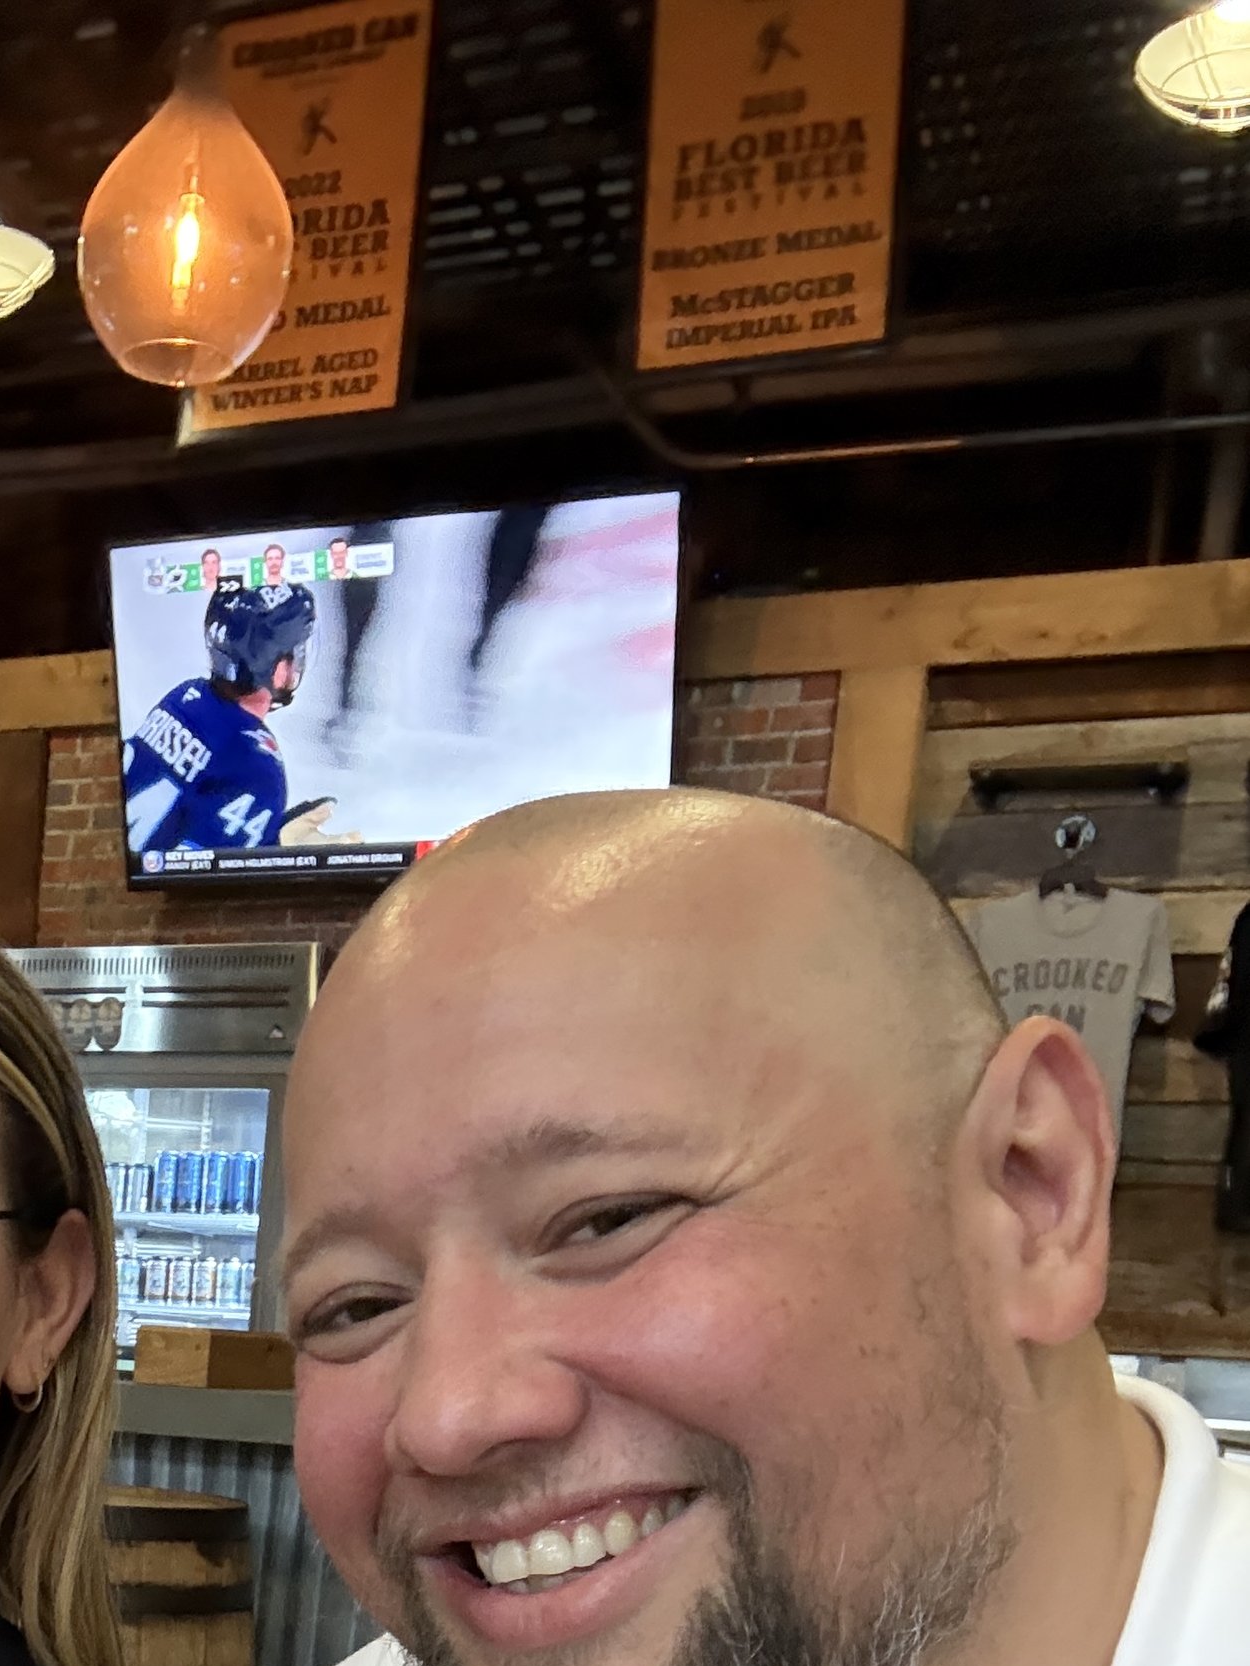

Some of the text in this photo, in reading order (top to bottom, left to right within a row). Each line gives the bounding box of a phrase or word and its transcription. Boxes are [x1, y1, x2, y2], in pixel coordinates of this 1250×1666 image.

[678, 118, 866, 174] FLORIDA
[675, 149, 866, 202] BEST BEER
[311, 229, 389, 260] BEER
[652, 220, 882, 271] BRONZE MEDAL
[296, 295, 390, 327] MEDAL
[671, 272, 855, 317] McSTAGGER
[667, 305, 855, 349] IMPERIAL IPA
[312, 348, 377, 374] AGED
[212, 374, 377, 410] WINTER'S NAP
[219, 794, 273, 849] 44
[992, 958, 1128, 996] CROOKED
